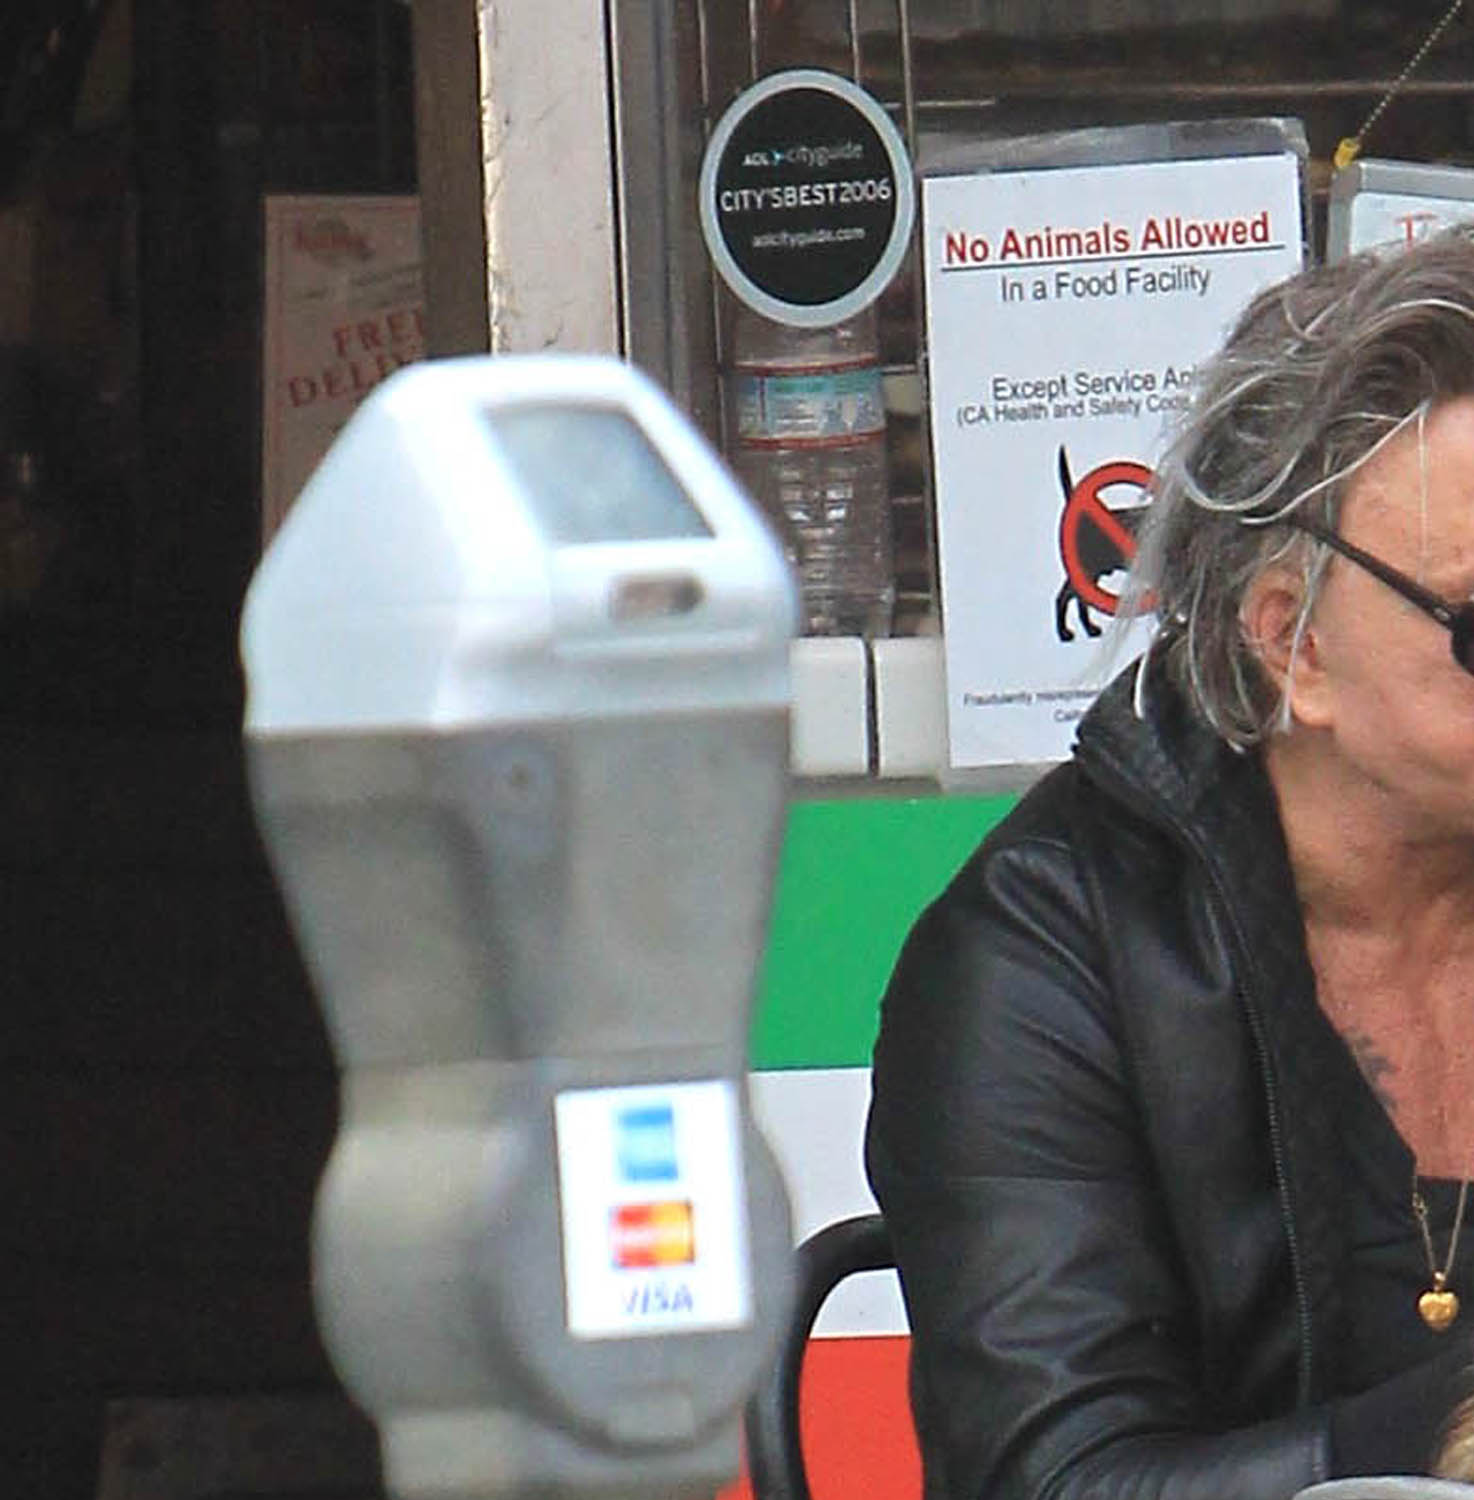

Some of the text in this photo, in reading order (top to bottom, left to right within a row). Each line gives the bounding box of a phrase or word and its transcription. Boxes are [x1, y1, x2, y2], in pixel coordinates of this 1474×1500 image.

[945, 210, 1271, 265] No Animals Allowed
[1002, 263, 1212, 303] In a Food Facility
[992, 373, 1069, 403] Except
[1074, 367, 1157, 395] Service
[956, 404, 989, 427] (CA
[994, 401, 1049, 423] Health
[1053, 399, 1085, 419] and
[1089, 396, 1141, 418] Safety
[623, 1283, 694, 1314] VISA
